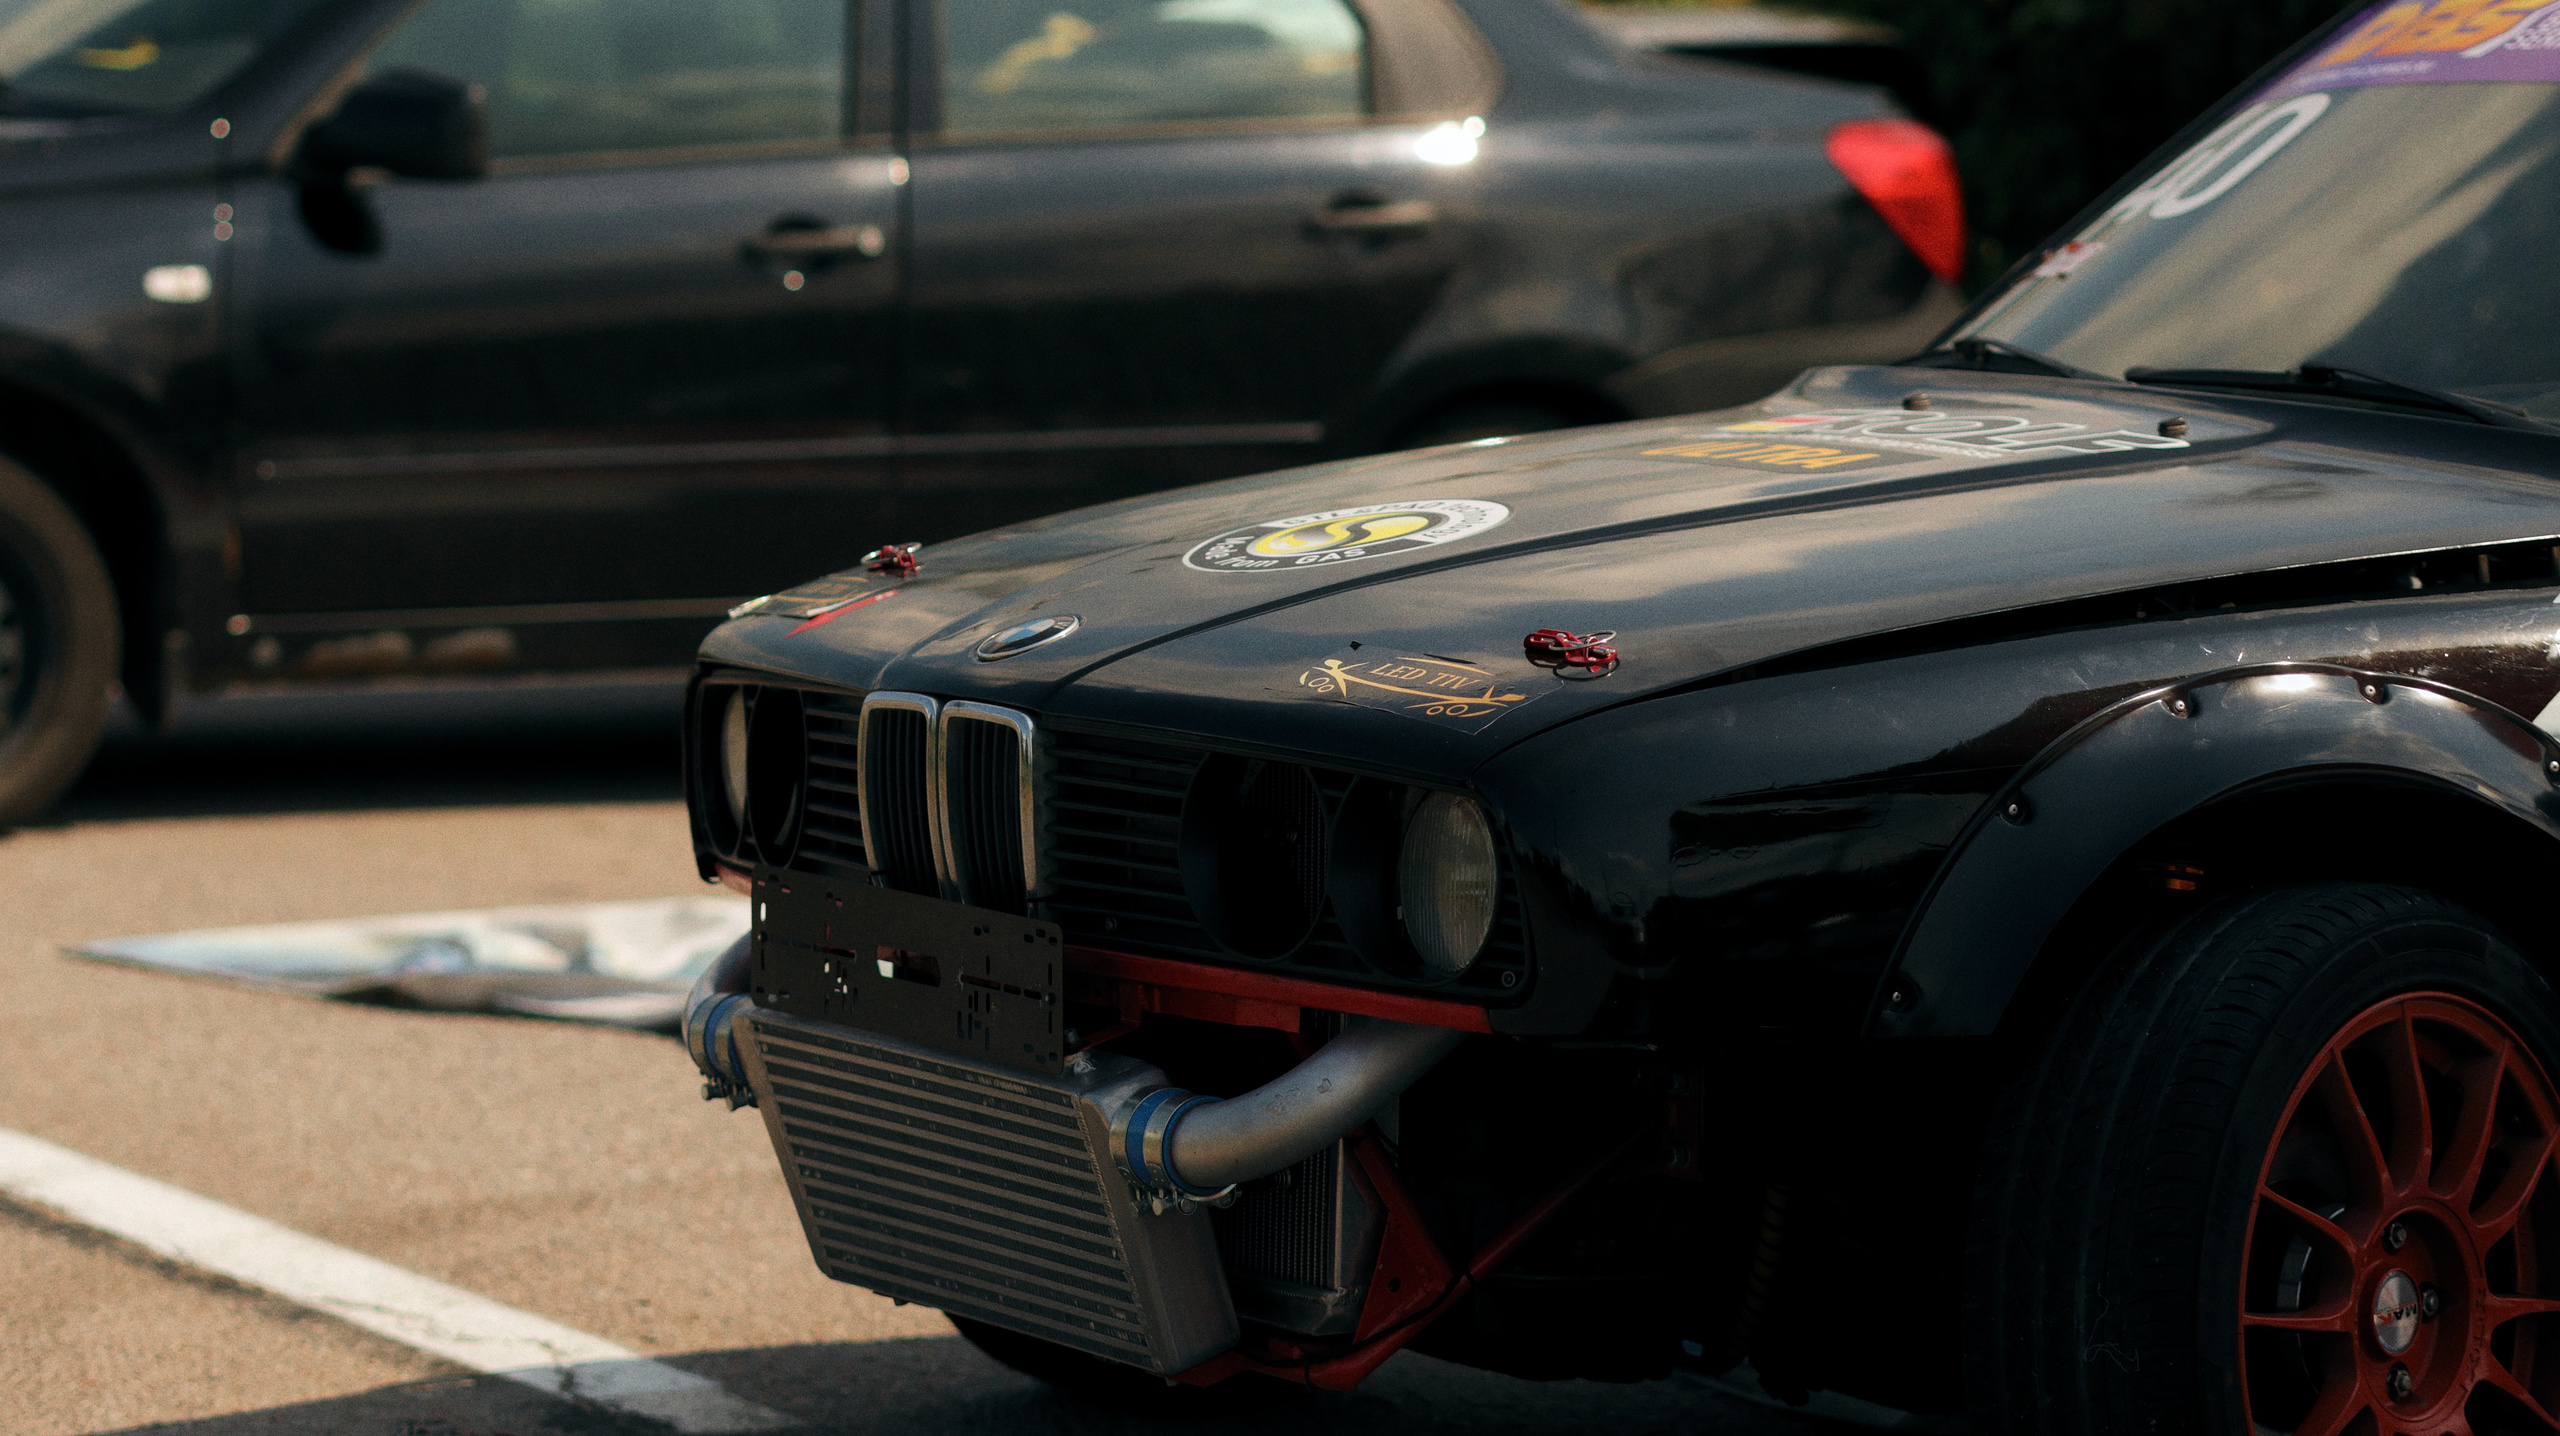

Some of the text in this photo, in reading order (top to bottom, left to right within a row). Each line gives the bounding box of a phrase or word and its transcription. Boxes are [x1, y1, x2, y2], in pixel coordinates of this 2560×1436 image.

[1641, 440, 1880, 470] ULTRA
[1213, 555, 1279, 569] from
[1294, 548, 1366, 565] GAS
[1369, 662, 1427, 680] LED
[2376, 1303, 2418, 1326] MAK
